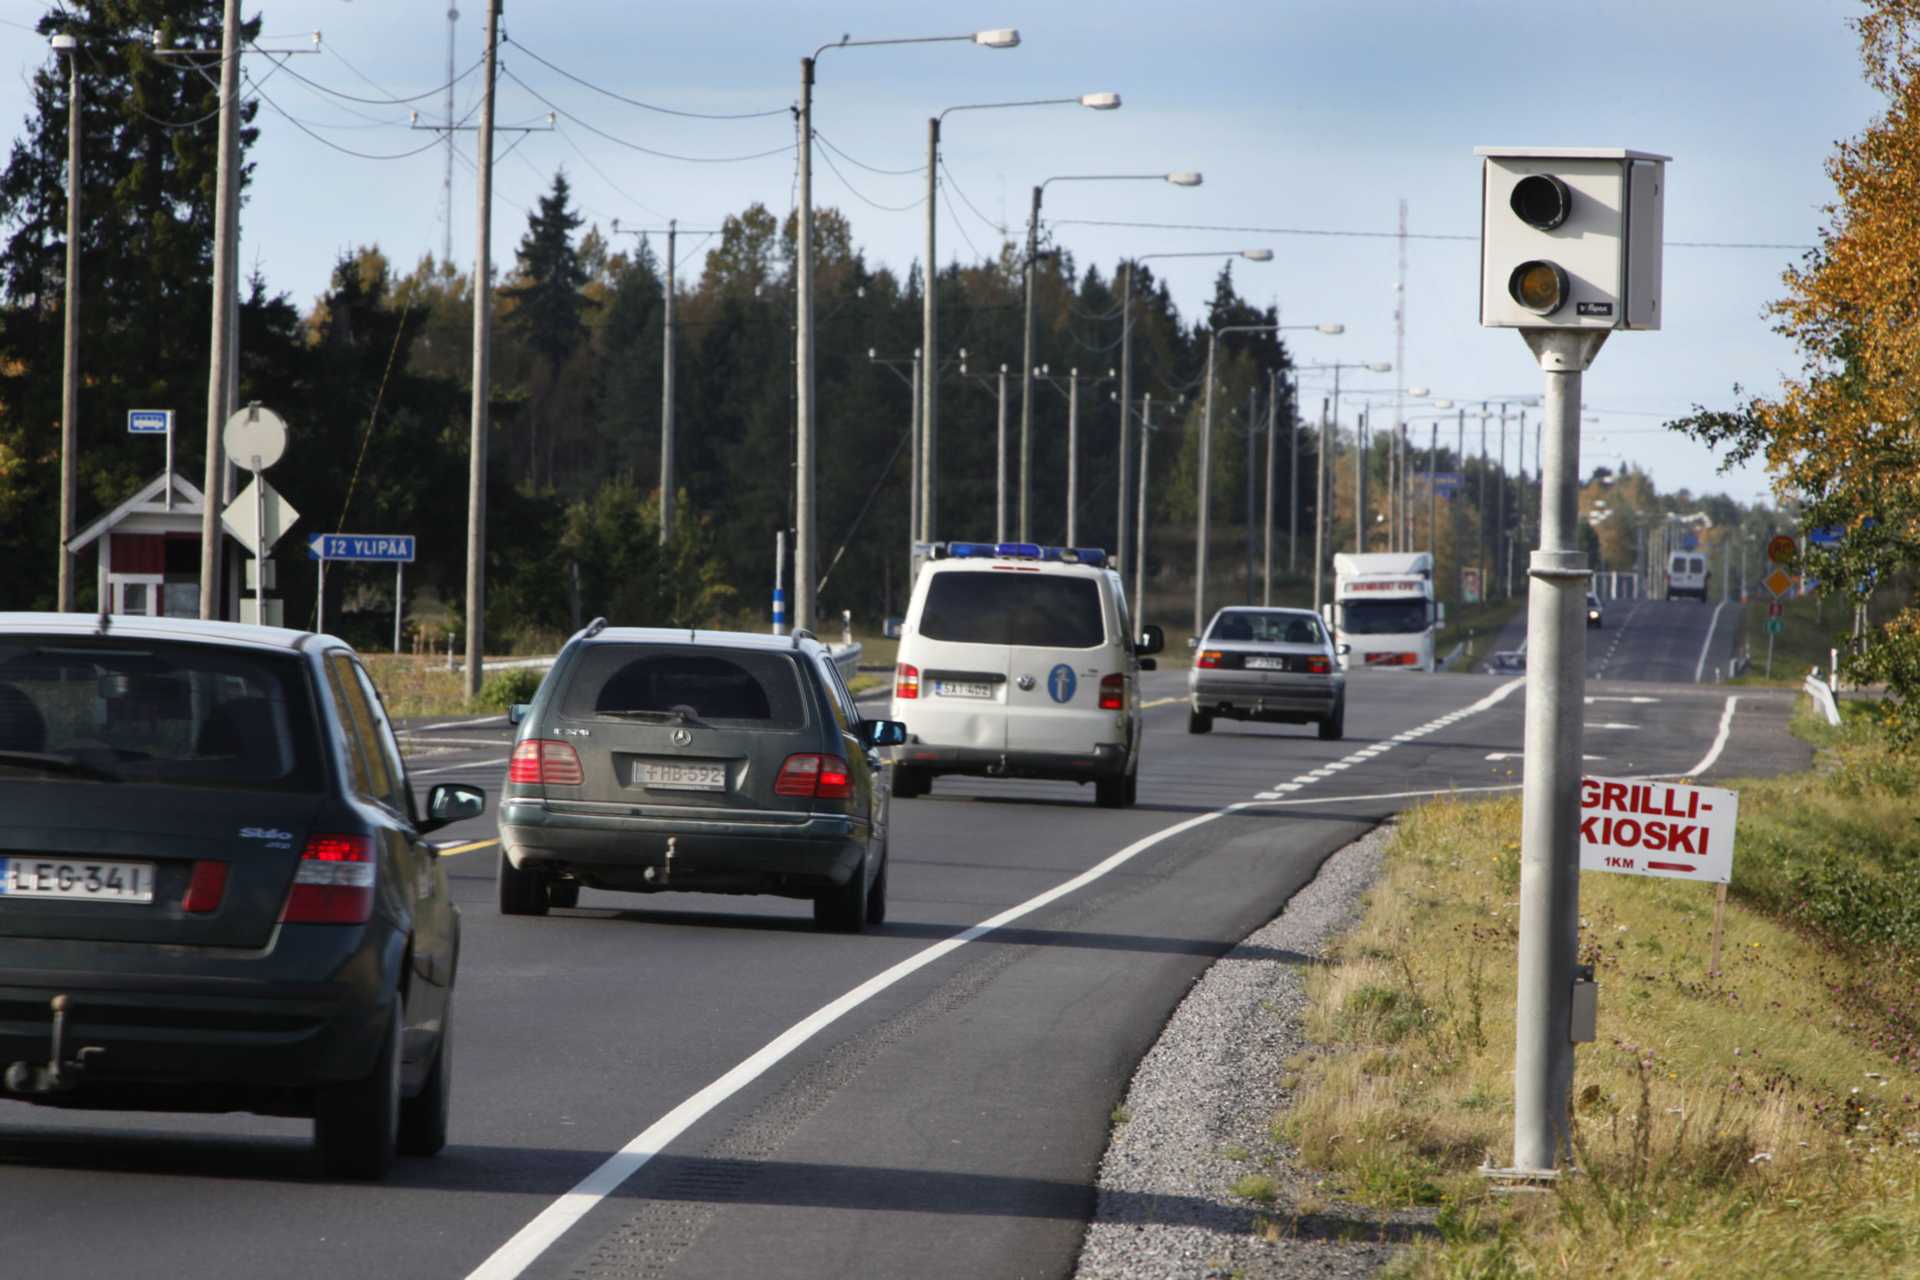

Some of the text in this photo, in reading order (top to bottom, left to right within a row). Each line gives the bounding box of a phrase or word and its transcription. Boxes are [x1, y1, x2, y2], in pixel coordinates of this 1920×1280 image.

[331, 540, 408, 556] 12 YLIPÄÄ
[1581, 779, 1713, 819] GRILLI-
[1580, 816, 1710, 855] KIOSKI
[1604, 857, 1634, 868] 1KM
[12, 863, 139, 895] LEG-341
